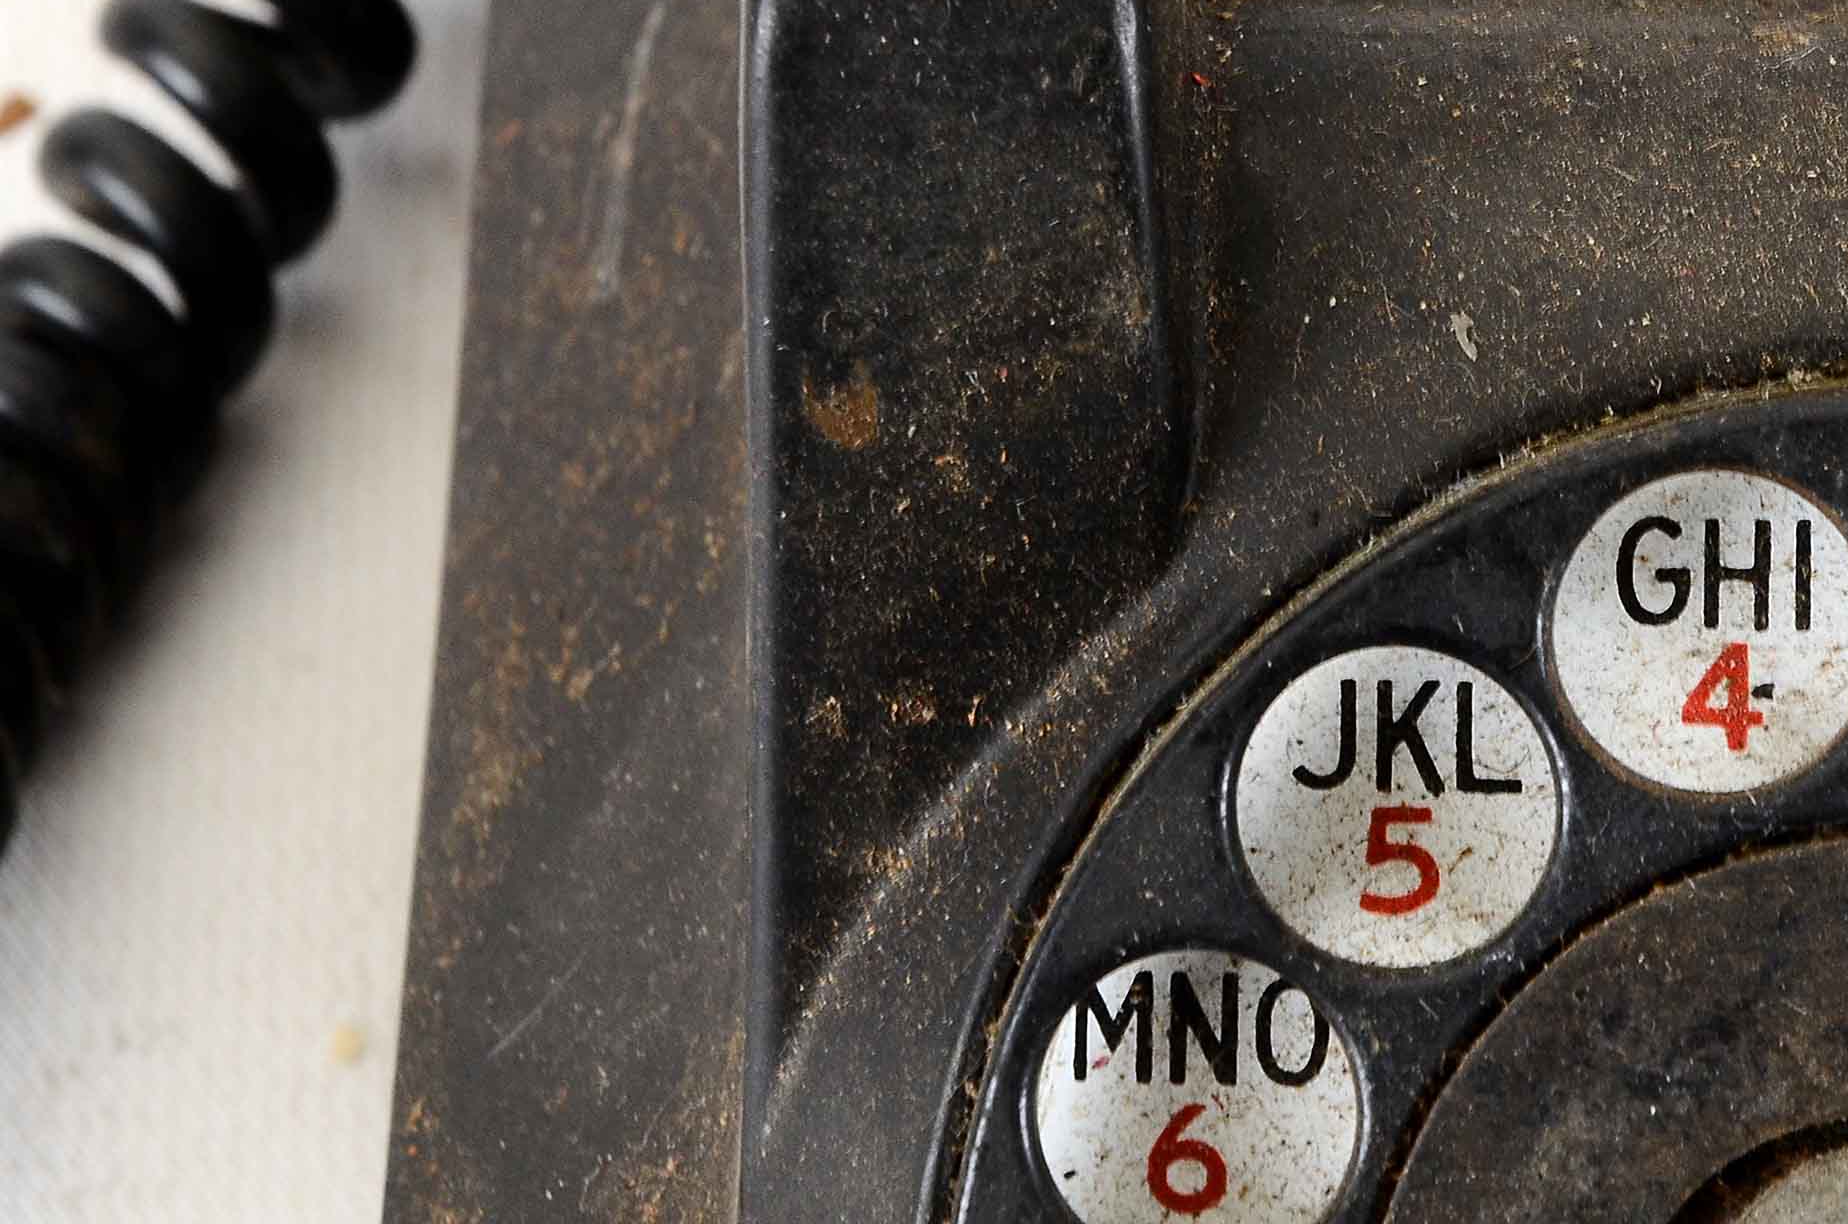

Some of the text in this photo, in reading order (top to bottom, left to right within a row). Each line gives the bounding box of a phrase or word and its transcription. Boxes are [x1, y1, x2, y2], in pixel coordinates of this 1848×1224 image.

[1615, 514, 1812, 632] GHI
[1292, 678, 1523, 799] JKL
[1680, 640, 1766, 754] 4
[1359, 803, 1441, 917] 5
[1072, 968, 1330, 1088] MNO
[1146, 1104, 1228, 1215] 6
